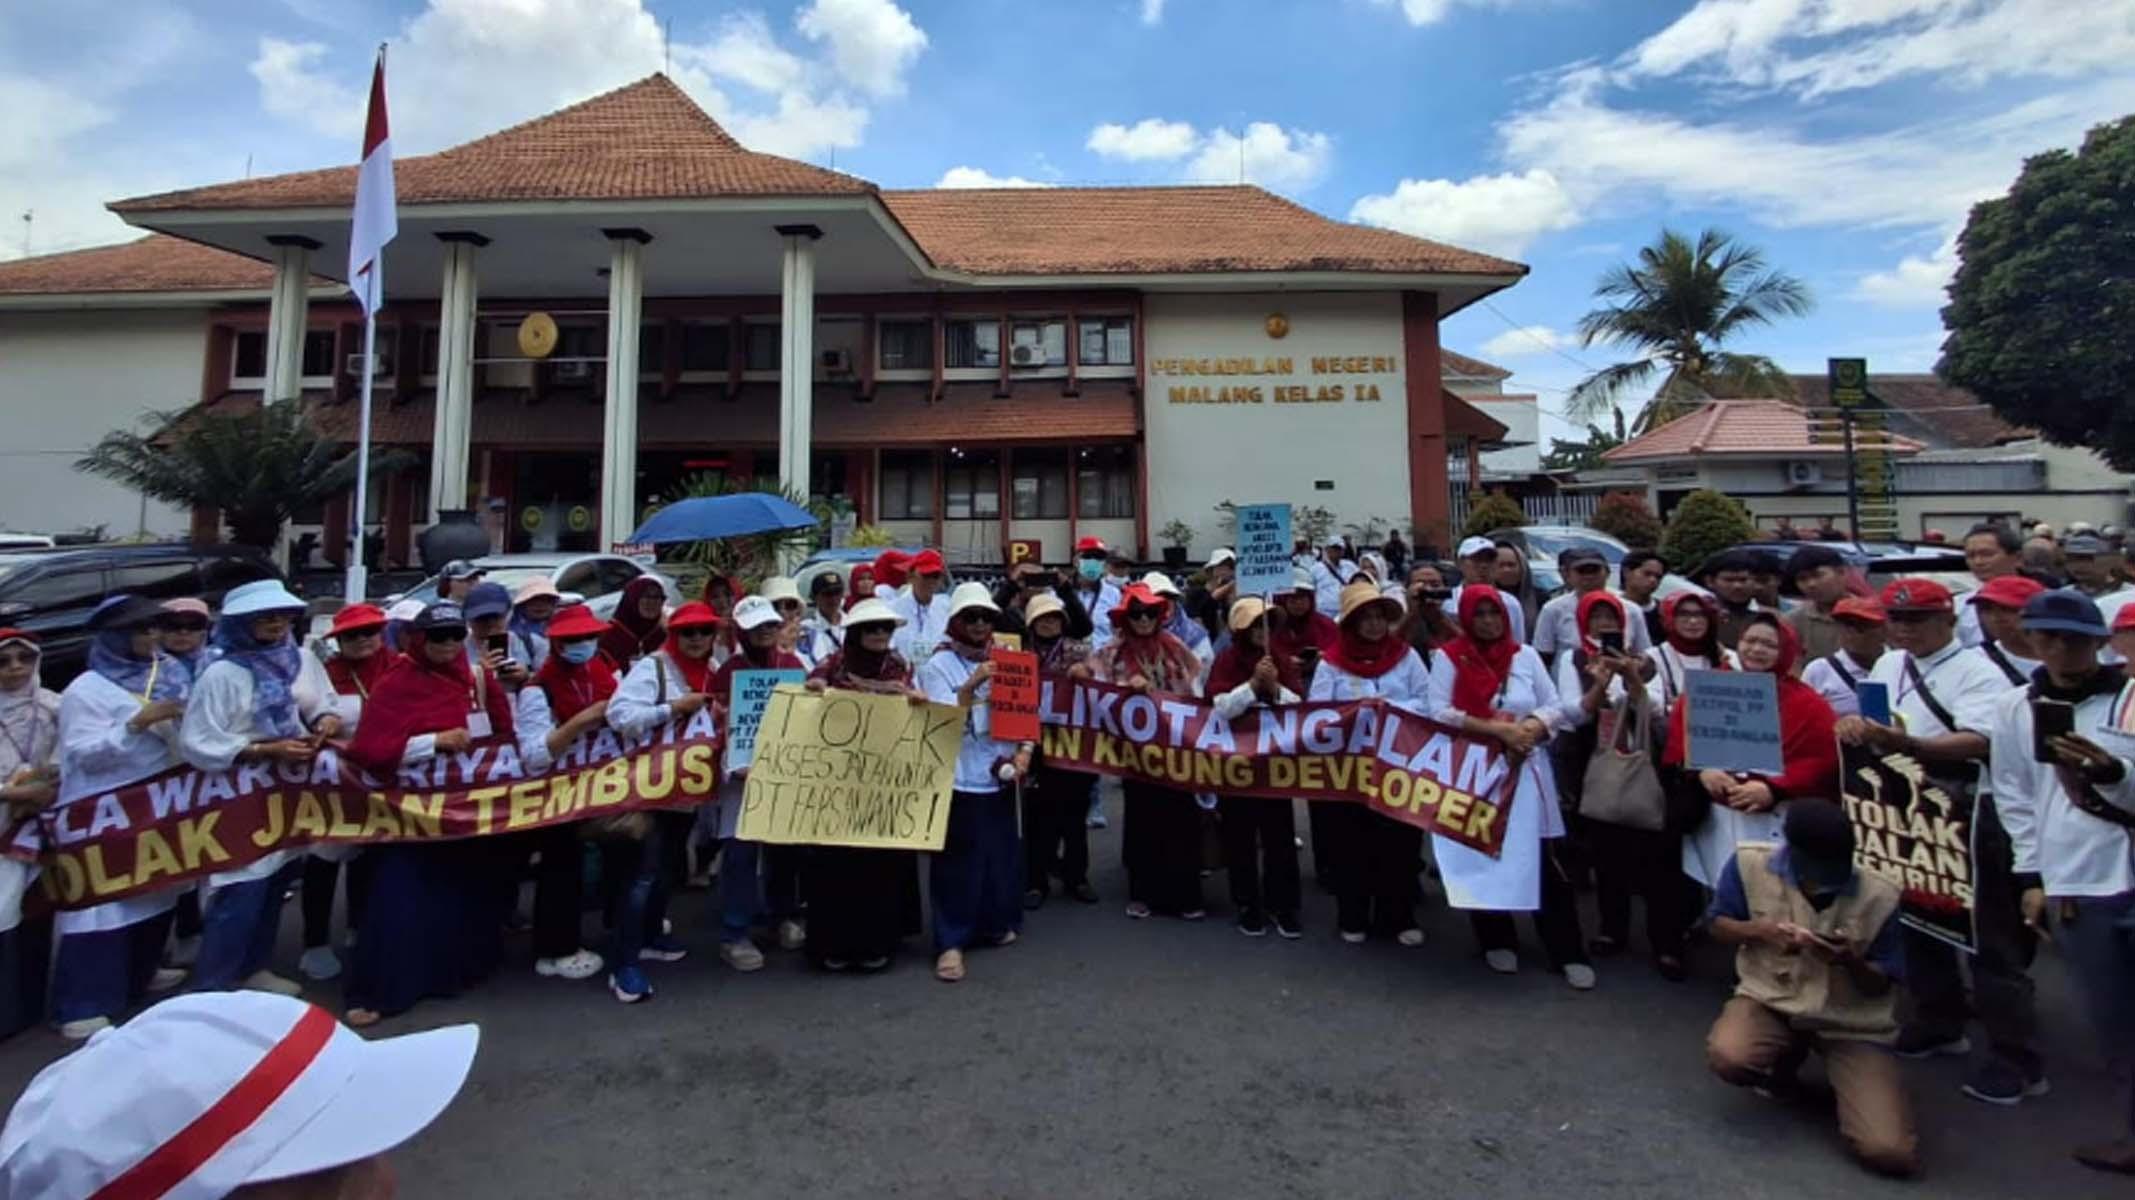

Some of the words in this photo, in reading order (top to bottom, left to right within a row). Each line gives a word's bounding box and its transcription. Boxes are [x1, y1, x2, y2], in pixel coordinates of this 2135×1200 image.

[1151, 357, 1293, 375] PENGADILAN
[1312, 356, 1397, 374] NEGERI
[1168, 386, 1263, 404] MALANG
[1274, 385, 1344, 403] KELAS
[1354, 384, 1381, 402] IA
[771, 690, 958, 766] TOLAK
[1257, 708, 1510, 806] NGALAM
[361, 743, 524, 787] RIYA
[757, 742, 833, 779] AKSES
[1093, 732, 1253, 788] KACUNG
[1269, 756, 1498, 844] DEVELOPER
[40, 811, 230, 903] OLAK
[251, 789, 445, 849] JALAN
[467, 744, 713, 835] TEMBUS
[742, 778, 791, 834] PT
[1843, 793, 1968, 854] TOLAK
